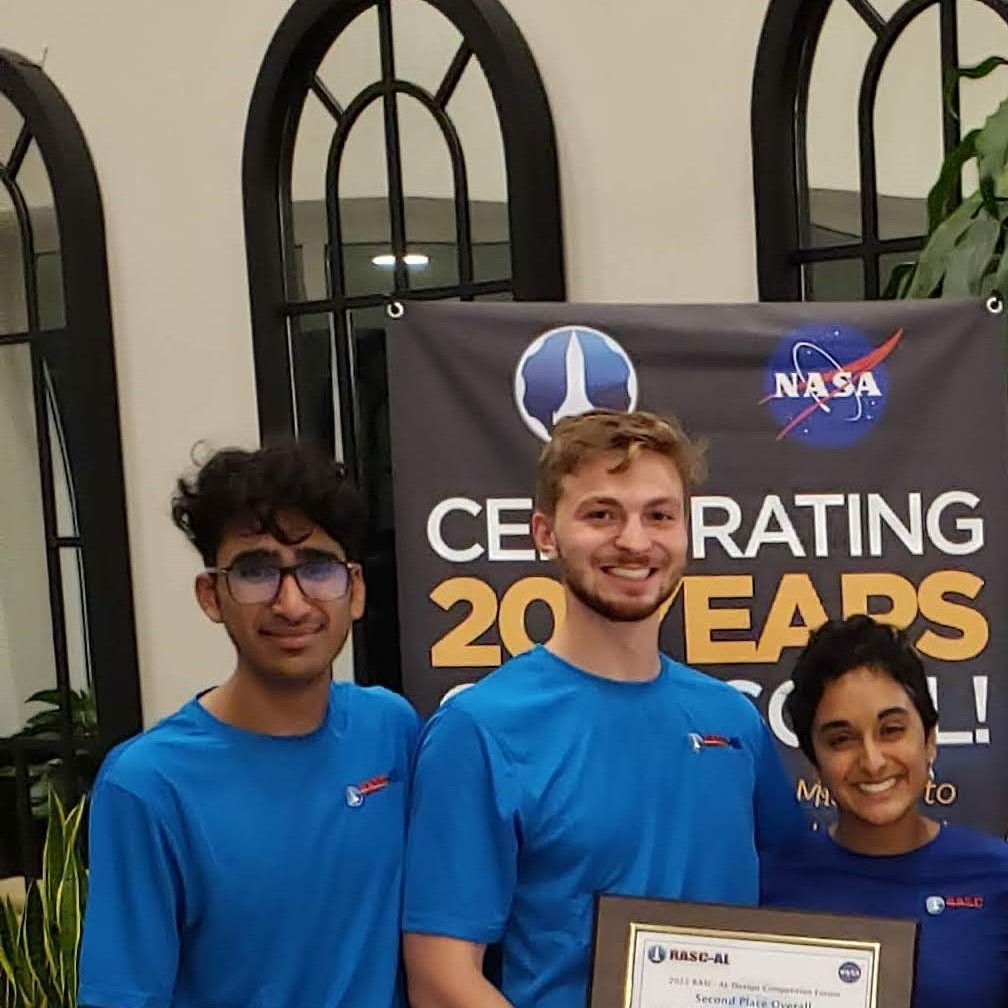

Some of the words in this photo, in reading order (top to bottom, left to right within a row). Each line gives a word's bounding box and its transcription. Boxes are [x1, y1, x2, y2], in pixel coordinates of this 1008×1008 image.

[774, 371, 881, 398] NASA
[427, 491, 985, 562] CERATING
[429, 576, 567, 667] 20
[924, 780, 957, 805] to
[669, 949, 730, 965] RASC-AL
[695, 993, 735, 1006] Second
[739, 997, 767, 1008] Place
